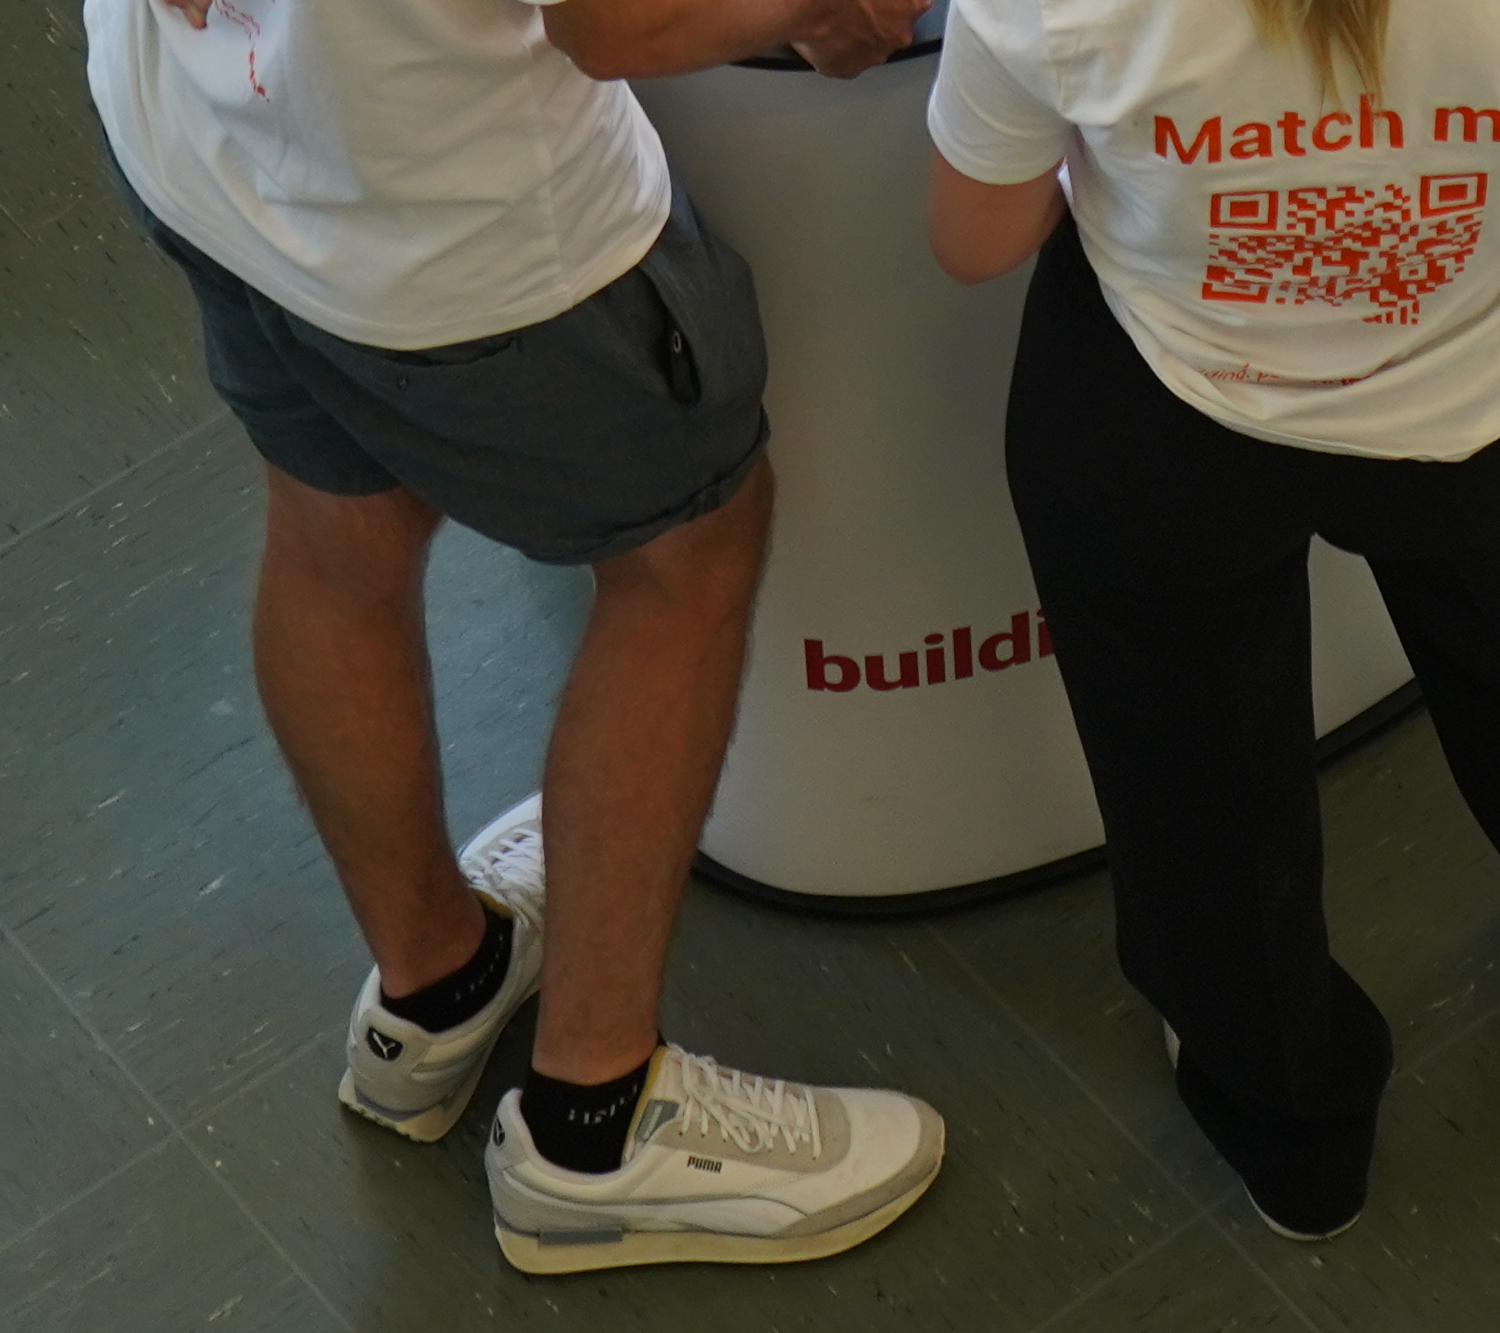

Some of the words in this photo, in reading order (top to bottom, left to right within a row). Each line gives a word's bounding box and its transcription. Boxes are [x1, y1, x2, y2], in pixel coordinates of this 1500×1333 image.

[1152, 89, 1405, 166] Match
[803, 605, 1055, 692] buildi
[686, 1155, 723, 1174] PUMA
